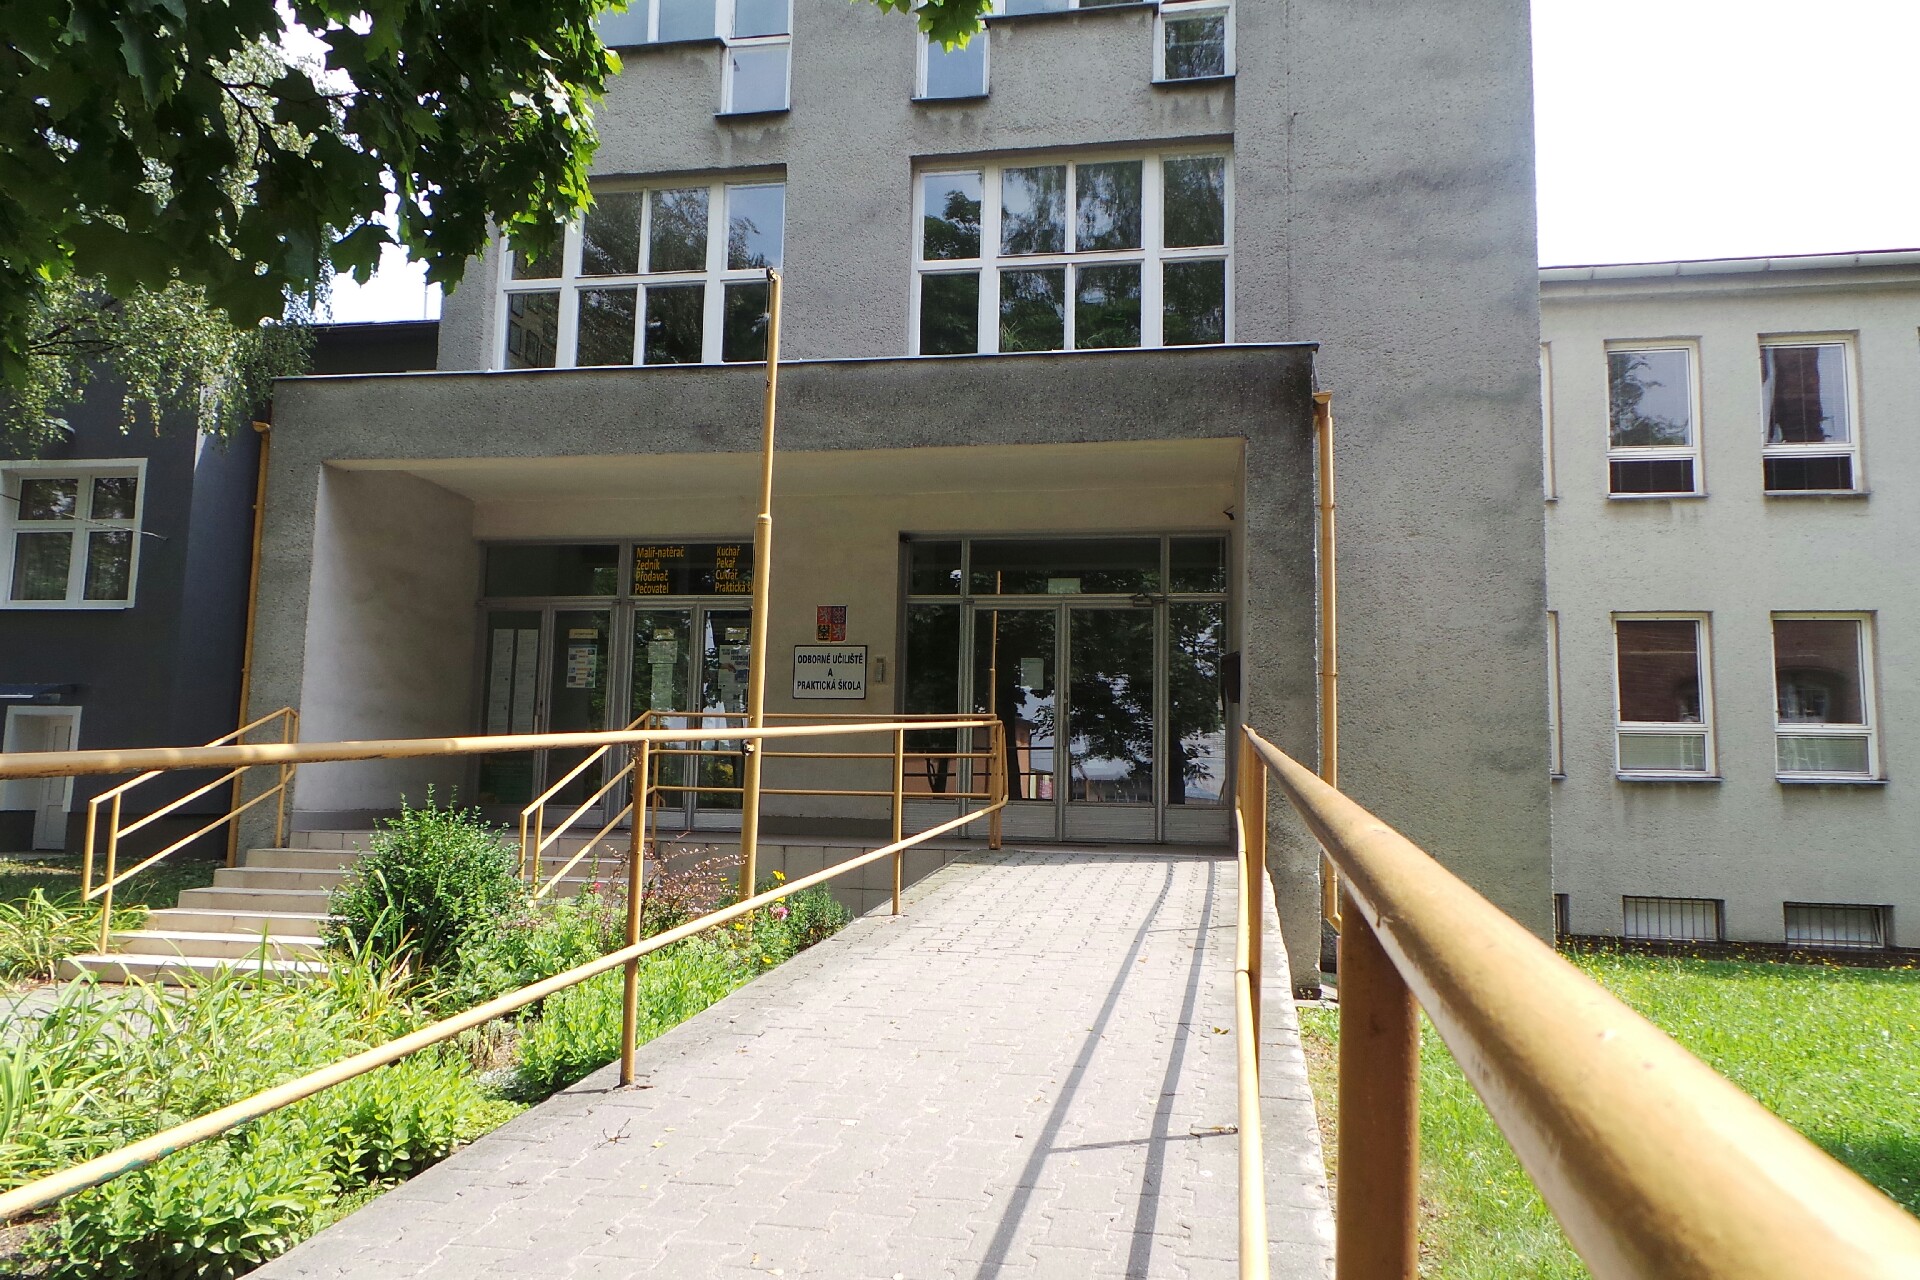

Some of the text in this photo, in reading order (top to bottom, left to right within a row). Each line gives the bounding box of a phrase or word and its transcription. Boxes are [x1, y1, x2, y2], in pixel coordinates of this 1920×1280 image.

[716, 545, 741, 557] Kuchař
[636, 559, 661, 571] Zedník
[716, 557, 736, 568] Pekař
[635, 570, 669, 582] Prodavač
[715, 568, 739, 580] Cukrář
[634, 582, 669, 594] Pečovatel
[714, 581, 746, 593] Praktická
[797, 653, 863, 664] ODBORNÉ UČILIŠTĚ
[827, 668, 833, 677] A
[797, 679, 862, 690] PRAKTICKÁ ŠKOLA
